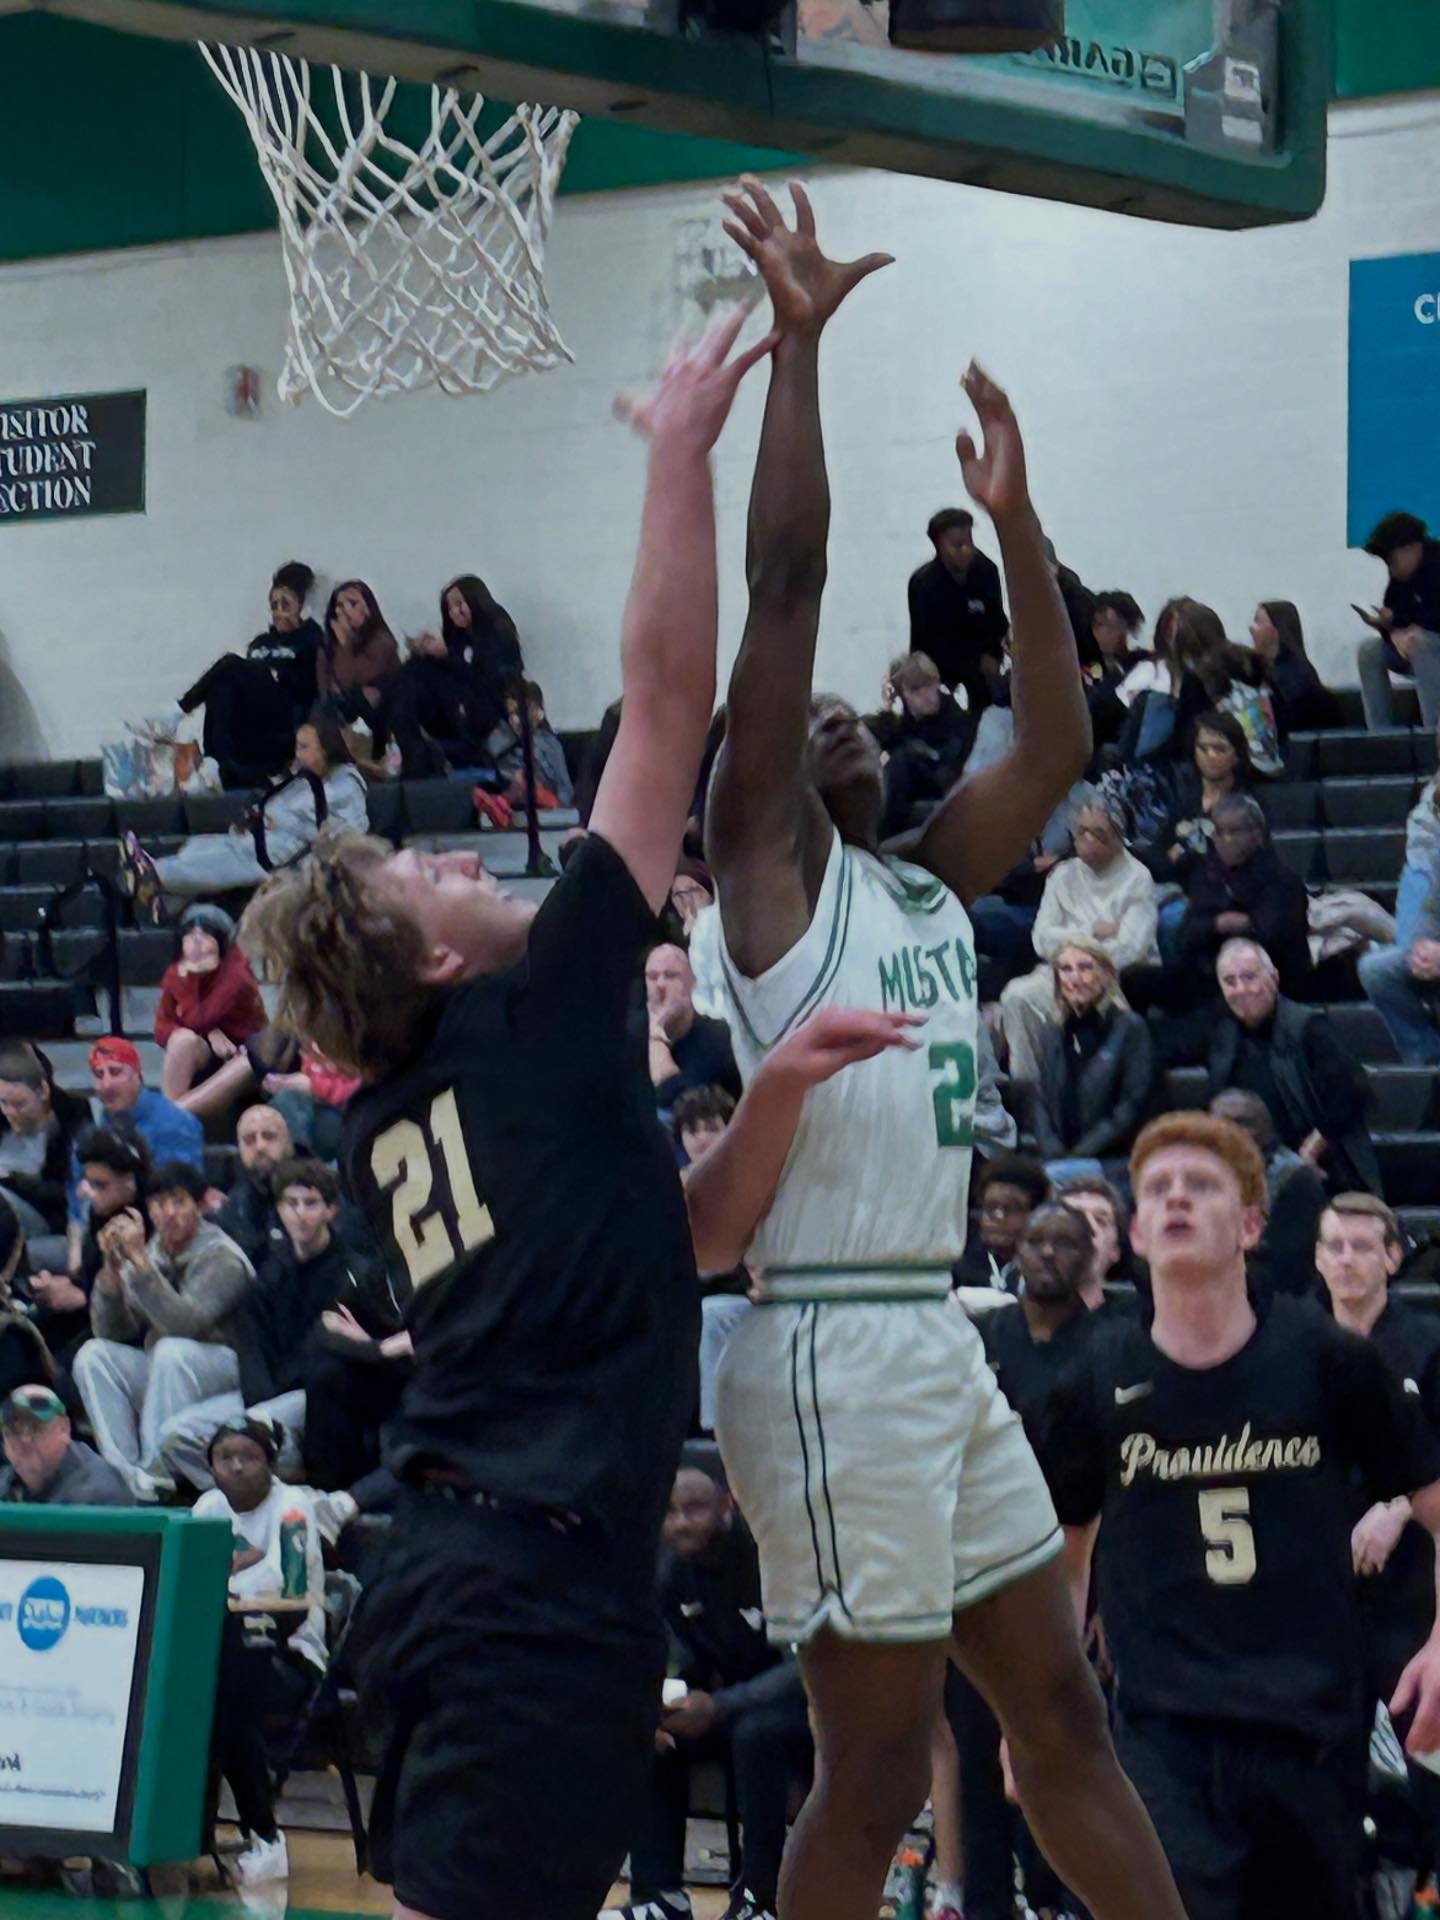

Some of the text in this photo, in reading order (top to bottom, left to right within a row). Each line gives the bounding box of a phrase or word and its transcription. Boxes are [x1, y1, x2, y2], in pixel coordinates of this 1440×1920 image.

[0, 404, 89, 440] ISITOR
[370, 1086, 496, 1289] 21
[1120, 1420, 1321, 1487] Providence
[1198, 1486, 1257, 1585] 5
